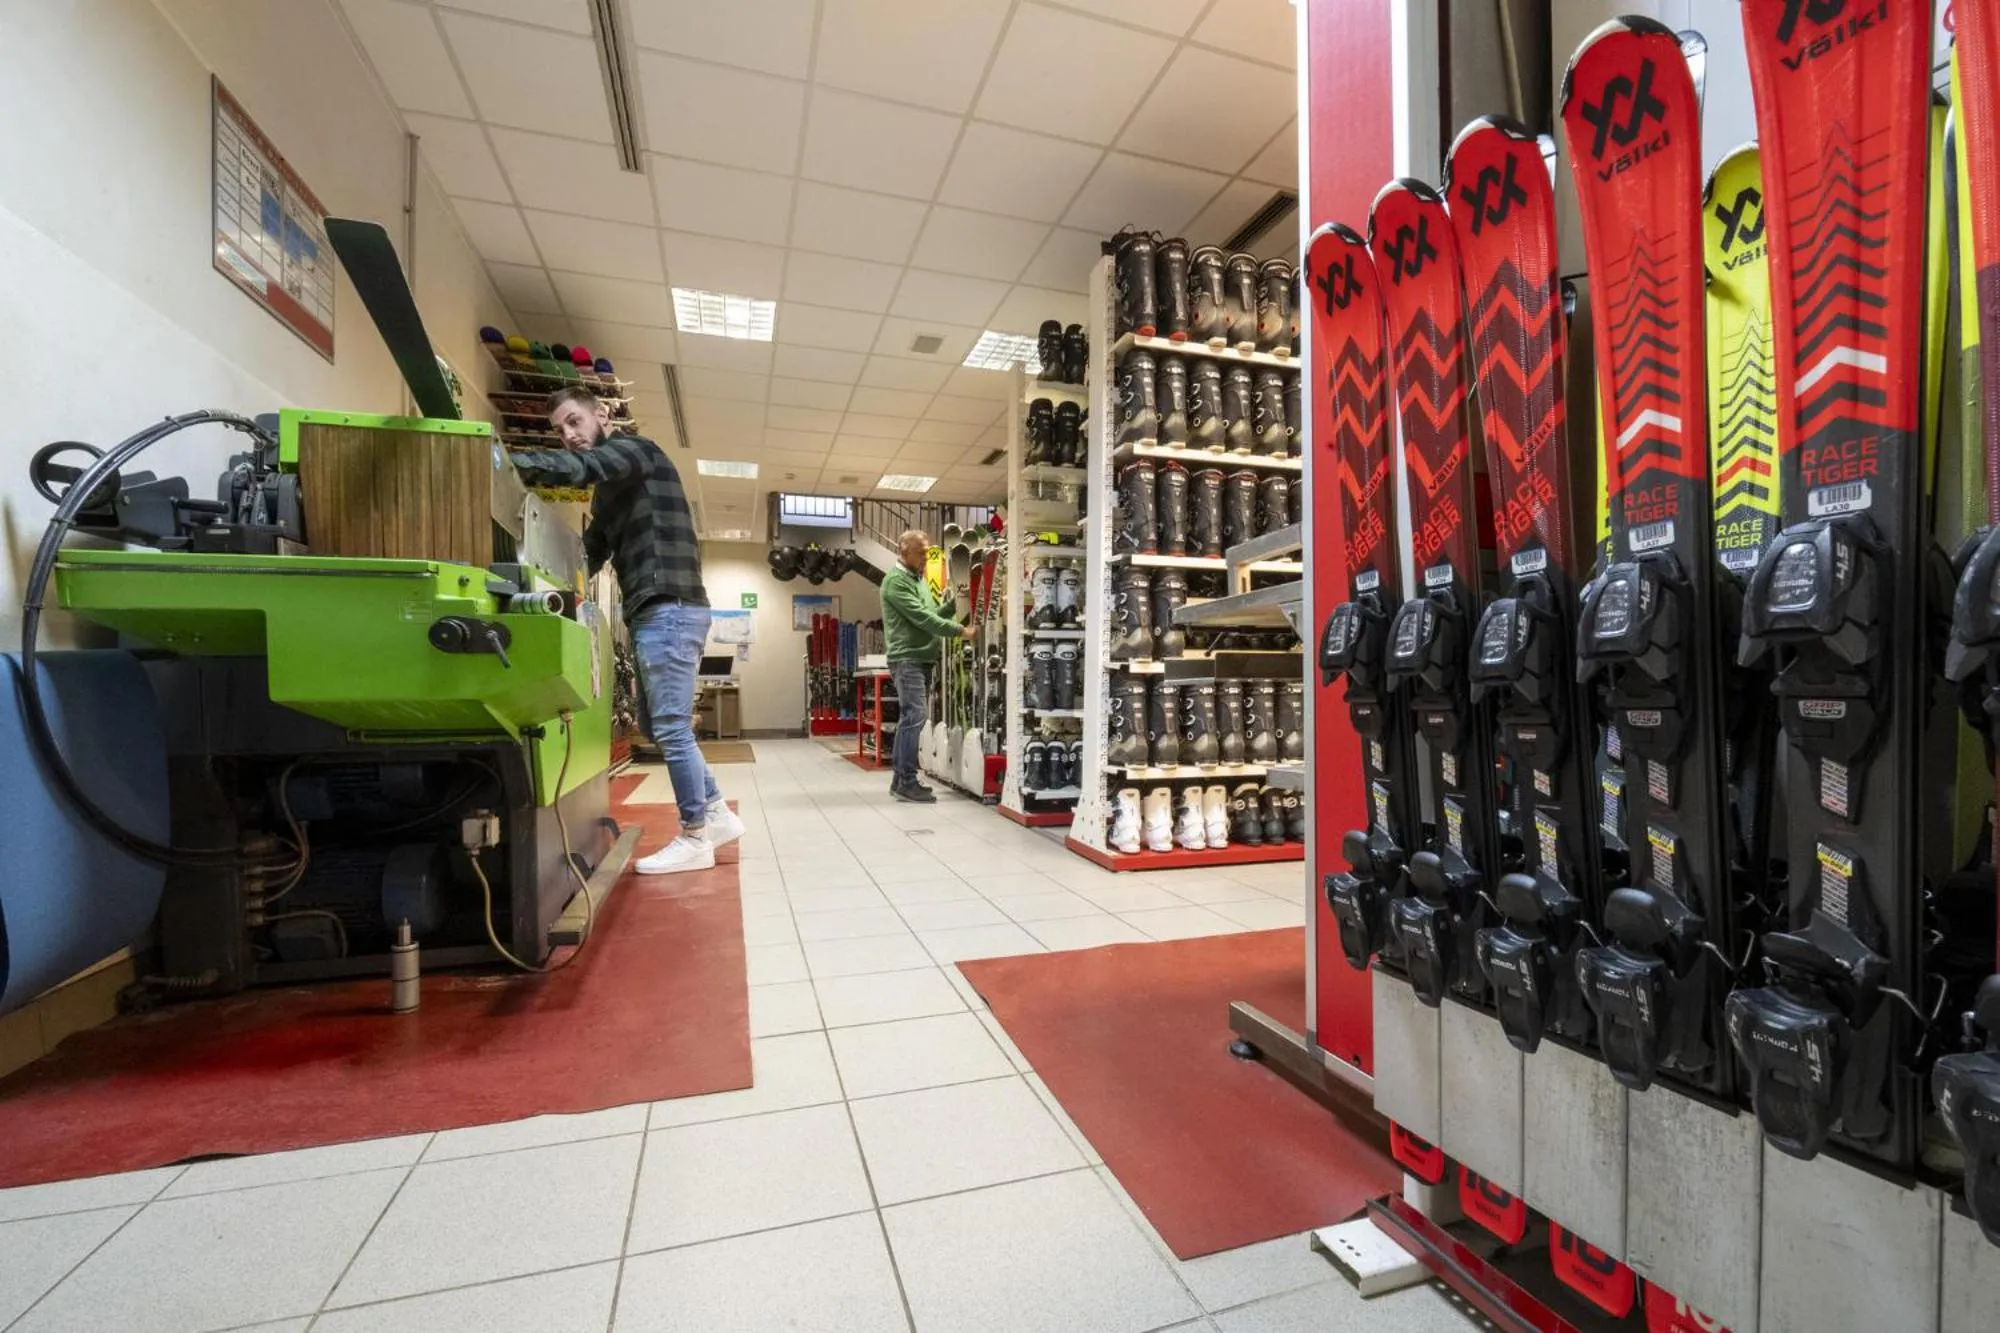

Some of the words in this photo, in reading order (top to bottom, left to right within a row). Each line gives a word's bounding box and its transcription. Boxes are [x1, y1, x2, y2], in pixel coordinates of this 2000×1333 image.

[1801, 436, 1879, 469] RACE
[1801, 457, 1879, 488] TIGER
[1494, 469, 1546, 531] RACE
[1624, 483, 1678, 508] RACE
[1624, 502, 1679, 525] TIGER
[1344, 508, 1378, 556] RACE
[1413, 494, 1453, 549] RACE
[1496, 482, 1557, 549] TIGER
[1716, 518, 1763, 537] RACE
[1345, 519, 1385, 571] TIGER
[1415, 509, 1461, 566] TIGER
[1716, 533, 1762, 550] TIGER
[1836, 542, 1849, 580] 4.5
[1640, 578, 1650, 611] 4.5
[1806, 1039, 1823, 1082] 4.5
